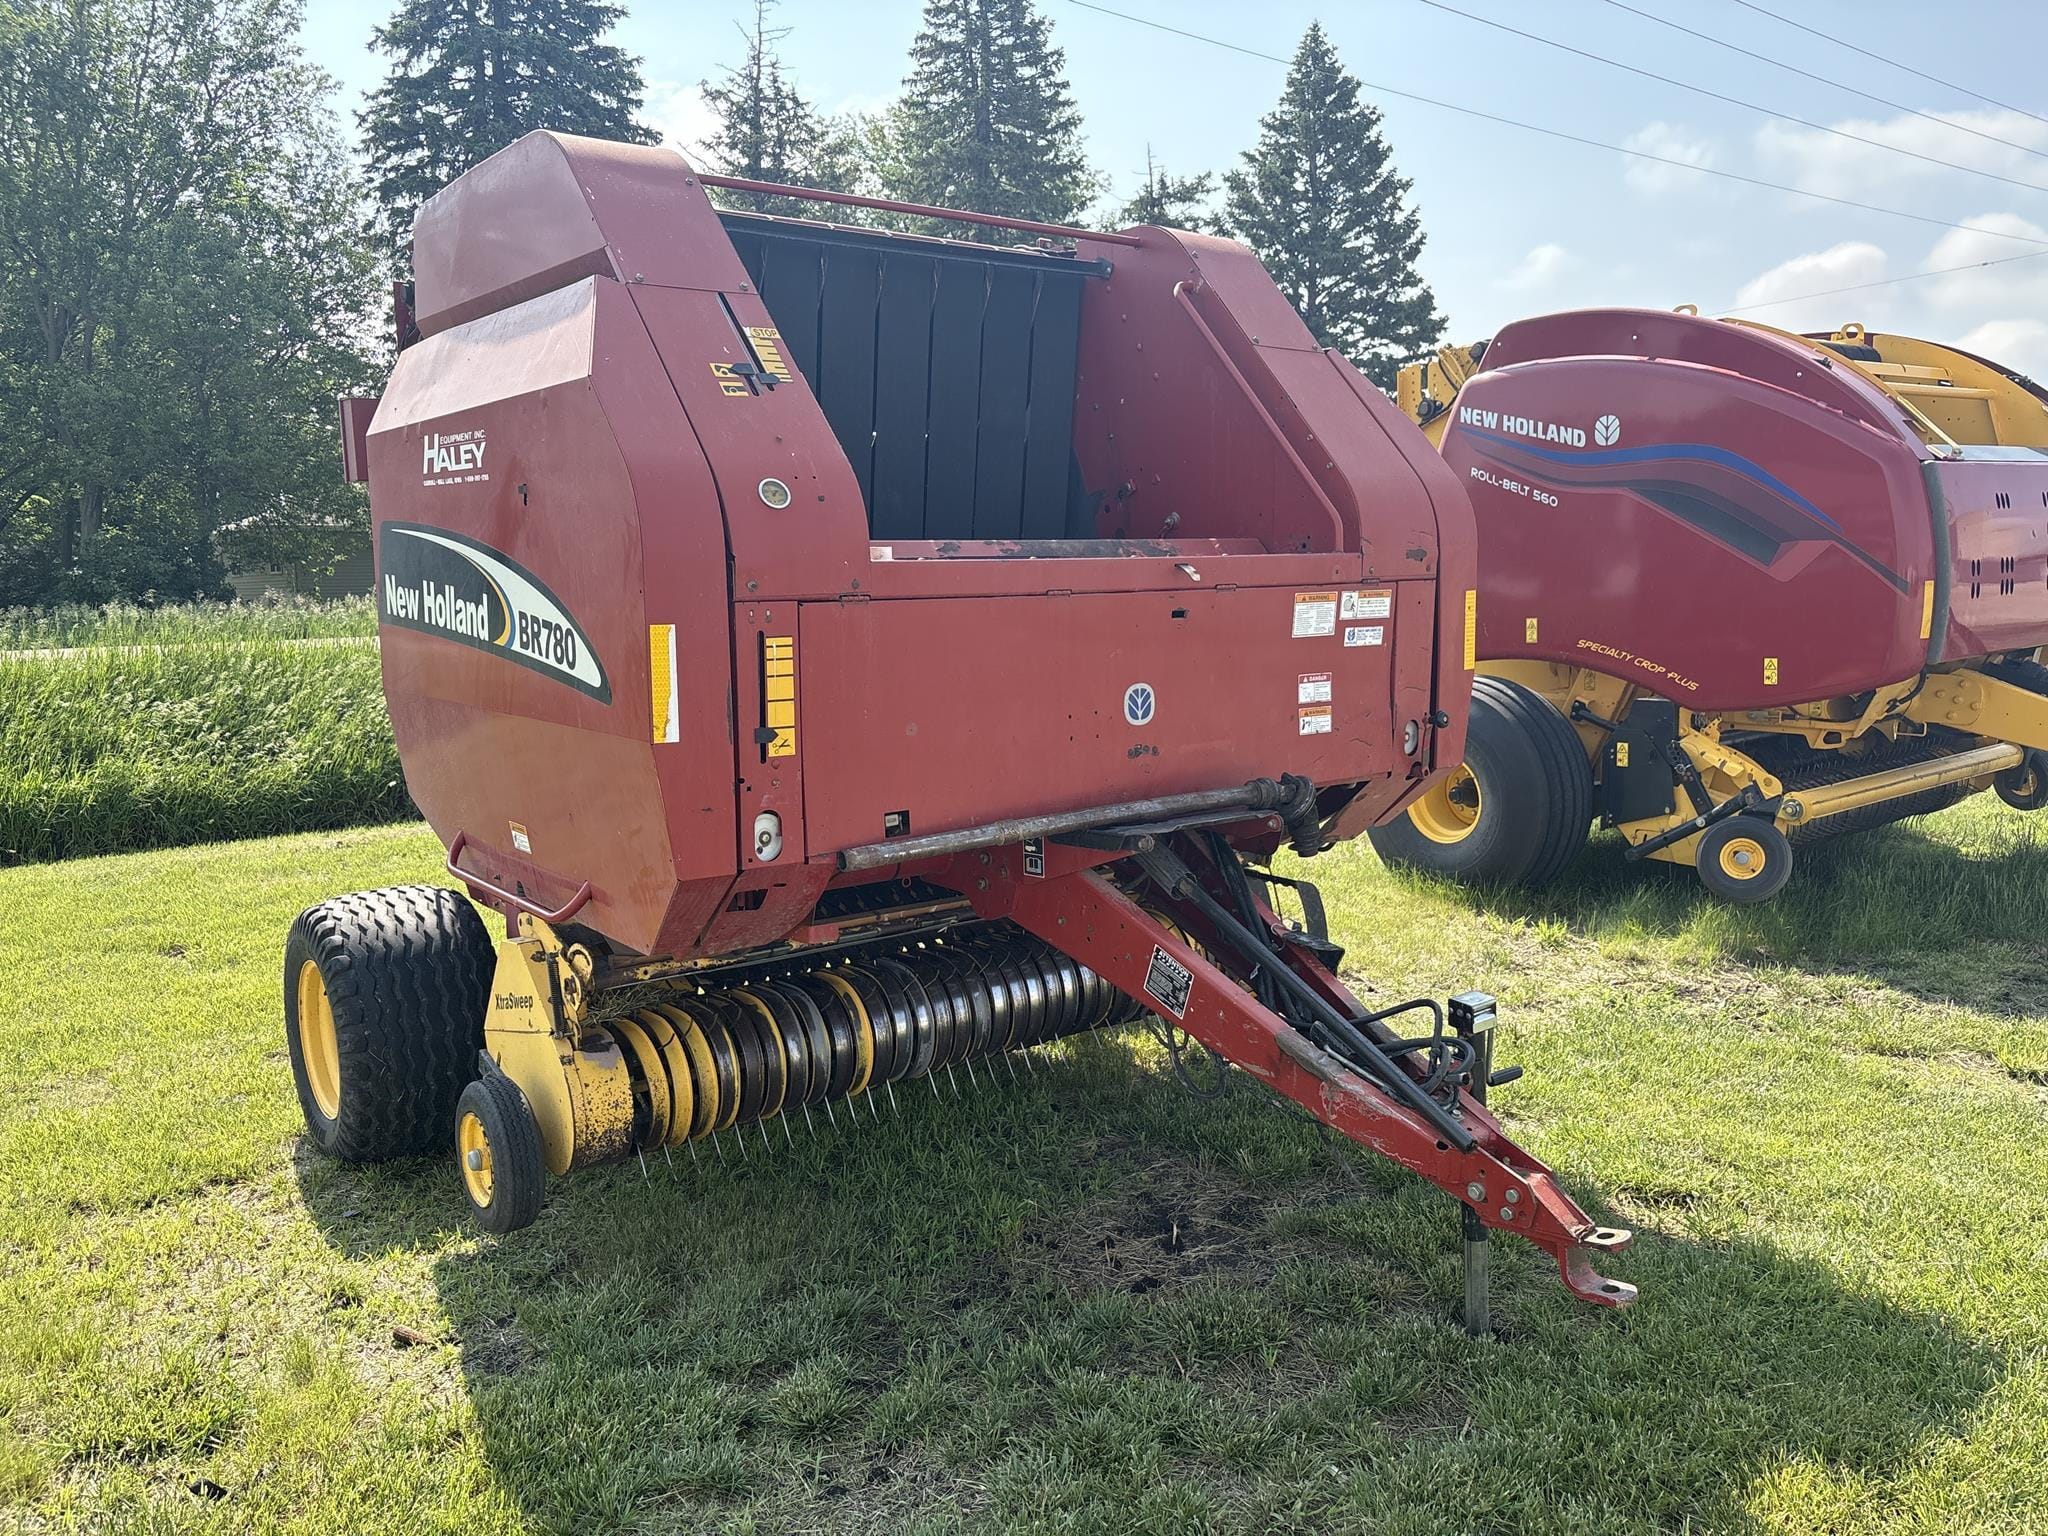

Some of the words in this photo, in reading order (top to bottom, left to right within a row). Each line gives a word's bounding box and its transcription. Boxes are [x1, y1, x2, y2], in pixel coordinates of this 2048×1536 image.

[753, 328, 777, 337] STOP
[439, 431, 472, 445] EQUIPMENT
[473, 429, 487, 439] INC.
[1460, 406, 1498, 429] NEW
[1502, 414, 1586, 448] HOLLAND
[1470, 467, 1530, 497] ROLL-BELT
[1532, 489, 1558, 507] 560
[384, 573, 419, 621] New
[422, 579, 489, 642] Holland
[518, 610, 577, 671] BR780
[1576, 639, 1634, 662] SPECIALTY
[1633, 657, 1667, 674] CROP
[1667, 671, 1699, 691] PLUS
[495, 992, 534, 1012] XtraSweep
